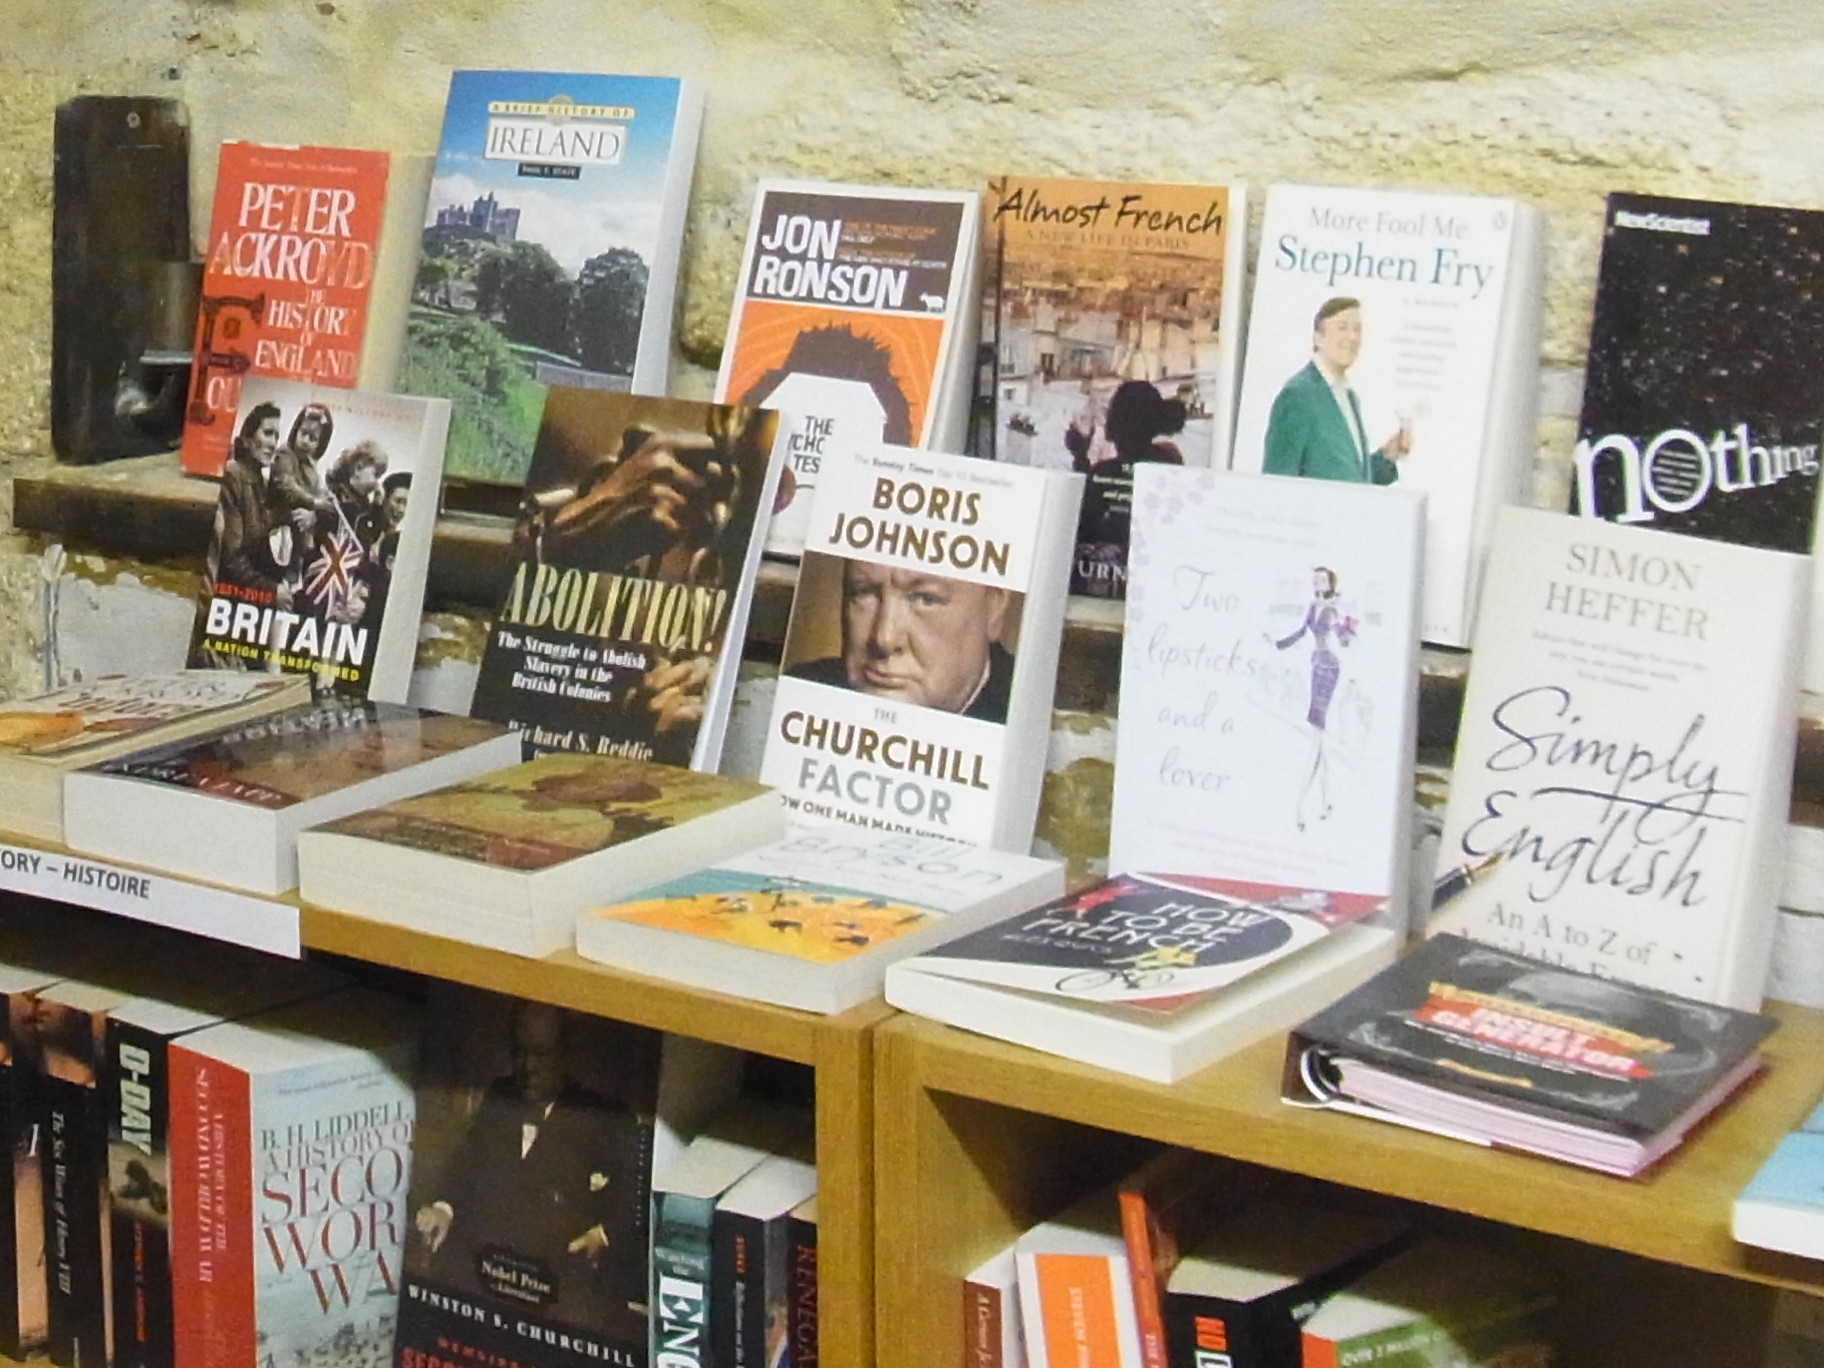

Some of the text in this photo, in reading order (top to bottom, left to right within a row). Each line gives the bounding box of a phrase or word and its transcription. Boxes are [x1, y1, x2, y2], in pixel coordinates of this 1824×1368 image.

[490, 127, 620, 159] IRELAND
[238, 182, 356, 237] PETER
[994, 187, 1223, 235] Almost French
[1310, 207, 1469, 239] More Fool Me
[208, 231, 372, 289] ACKROYD
[761, 214, 842, 260] JON
[753, 255, 908, 309] RONSON
[1275, 234, 1494, 299] Stephen Fry
[268, 299, 356, 335] HISTORY
[255, 339, 357, 378] ENGLAND
[806, 415, 834, 435] THE
[794, 454, 821, 474] TES
[1574, 423, 1819, 523] nothing
[872, 477, 981, 526] BORIS
[829, 513, 1010, 576] JOHNSON
[1566, 543, 1702, 591] SIMON
[499, 561, 727, 652] ABOLITION!
[1173, 564, 1238, 612] Two
[1545, 581, 1709, 641] HEFFER
[206, 597, 368, 666] BRITAIN
[498, 631, 647, 670] The Struggle to Abolish
[1148, 622, 1256, 678] lipsticks
[202, 638, 360, 682] A NATION TRANSFORMED
[523, 655, 614, 683] Slavery in the
[512, 671, 611, 703] British Colonies
[873, 707, 897, 724] THE
[1157, 690, 1234, 733] and a
[577, 732, 590, 752] S.
[597, 736, 653, 762] Reddie
[780, 710, 990, 790] CHURCHILL
[1159, 745, 1232, 791] lover
[1486, 686, 1748, 843] Simply
[798, 757, 953, 825] FACTOR
[803, 801, 833, 819] ONE
[835, 809, 869, 828] MAN
[1461, 790, 1707, 908] English
[63, 862, 151, 899] HISTOIRE
[1022, 918, 1217, 952] FRENCH
[1101, 910, 1244, 943] TO BE
[1152, 902, 1274, 927] HOW
[1487, 902, 1524, 929] An
[1534, 914, 1551, 939] A
[1564, 925, 1589, 947] to
[1598, 929, 1617, 956] Z
[1627, 941, 1657, 965] of
[120, 1043, 154, 1156] D-DAY
[263, 1130, 280, 1150] B.
[315, 1101, 410, 1141] LIDDELL
[264, 1151, 278, 1172] A
[287, 1128, 383, 1169] HISTORY
[197, 1068, 212, 1283] SECOND WORLD WAR
[263, 1147, 403, 1224] SECO
[264, 1199, 401, 1273] WOR
[307, 1250, 398, 1316] WA
[482, 1261, 517, 1284] Nobel
[407, 1284, 636, 1368] WINSTON S. CHURCHILL
[797, 1246, 817, 1368] RENEGA
